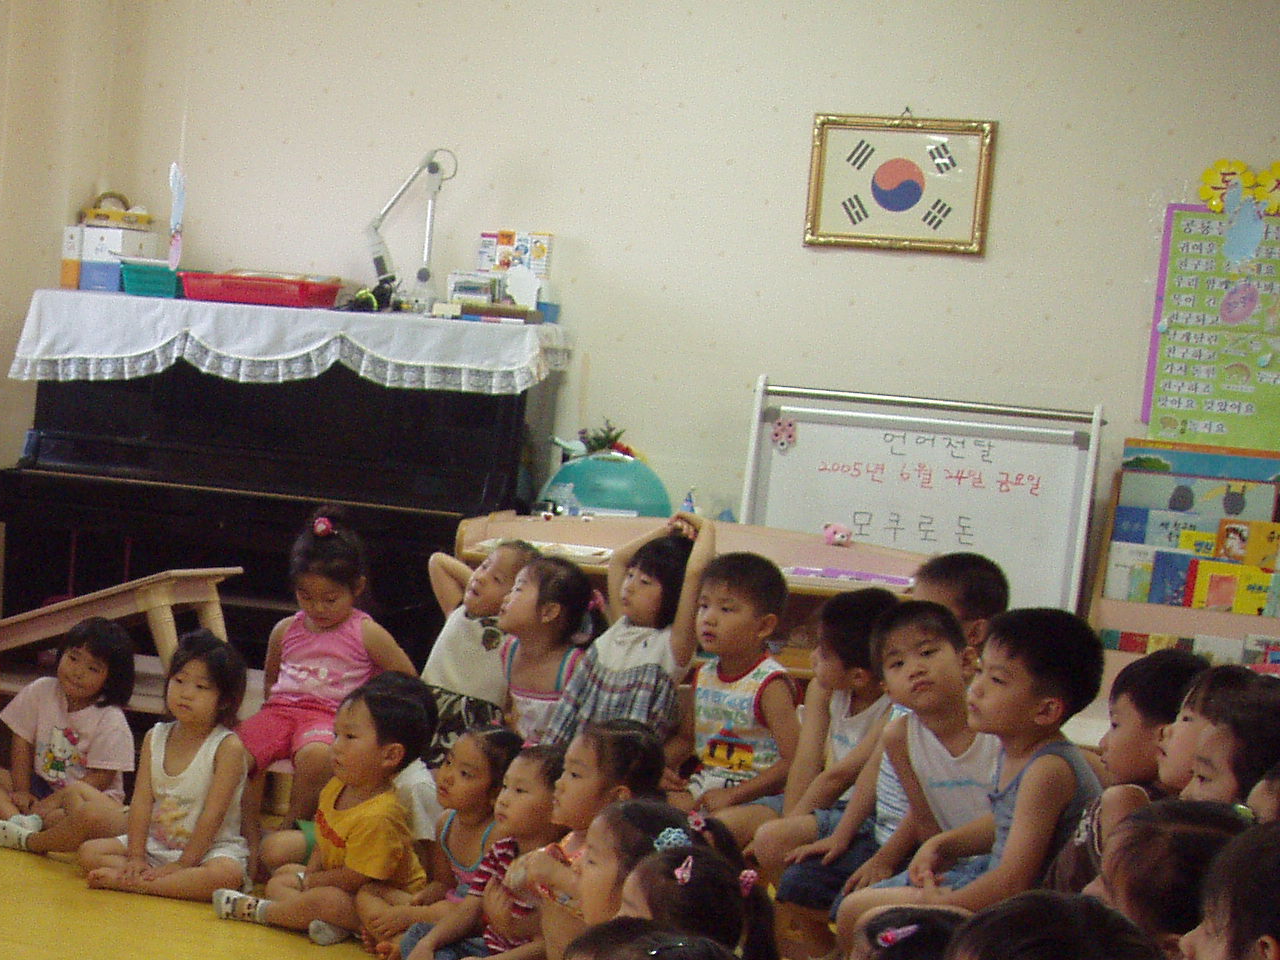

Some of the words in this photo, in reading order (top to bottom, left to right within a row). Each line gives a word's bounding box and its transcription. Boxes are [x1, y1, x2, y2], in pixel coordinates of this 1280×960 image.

[818, 460, 886, 483] 2005년
[899, 462, 933, 489] 6월
[944, 467, 986, 489] 24일
[996, 471, 1042, 497] 금요일
